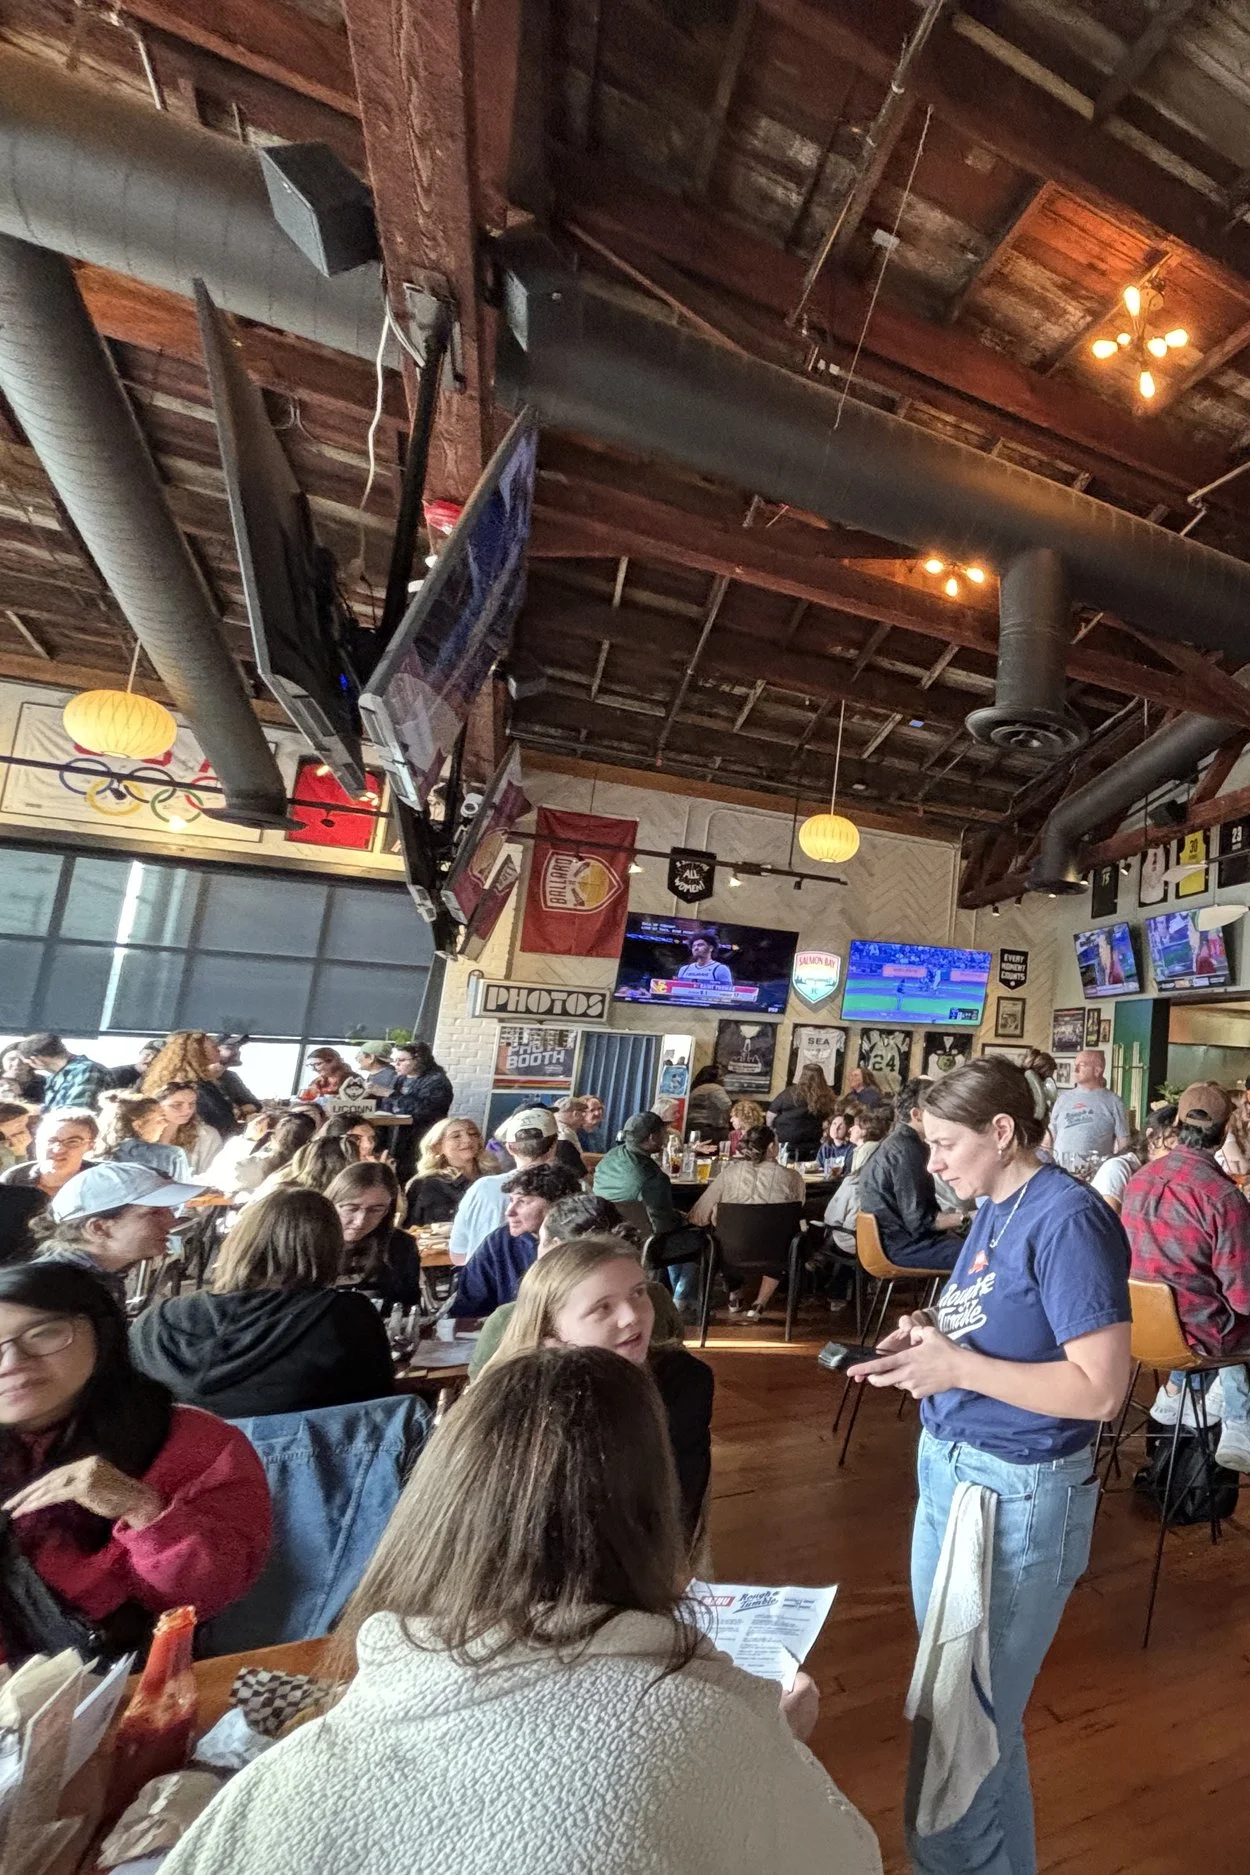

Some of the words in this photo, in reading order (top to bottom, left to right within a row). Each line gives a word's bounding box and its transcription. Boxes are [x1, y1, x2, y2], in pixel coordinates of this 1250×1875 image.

[549, 858, 573, 905] BALLARD
[683, 869, 700, 879] ALL
[485, 986, 603, 1016] PHOTOS
[807, 1037, 830, 1047] SEA
[506, 1050, 565, 1069] BOOTH
[872, 1054, 897, 1072] 24
[332, 1105, 373, 1113] UCONN
